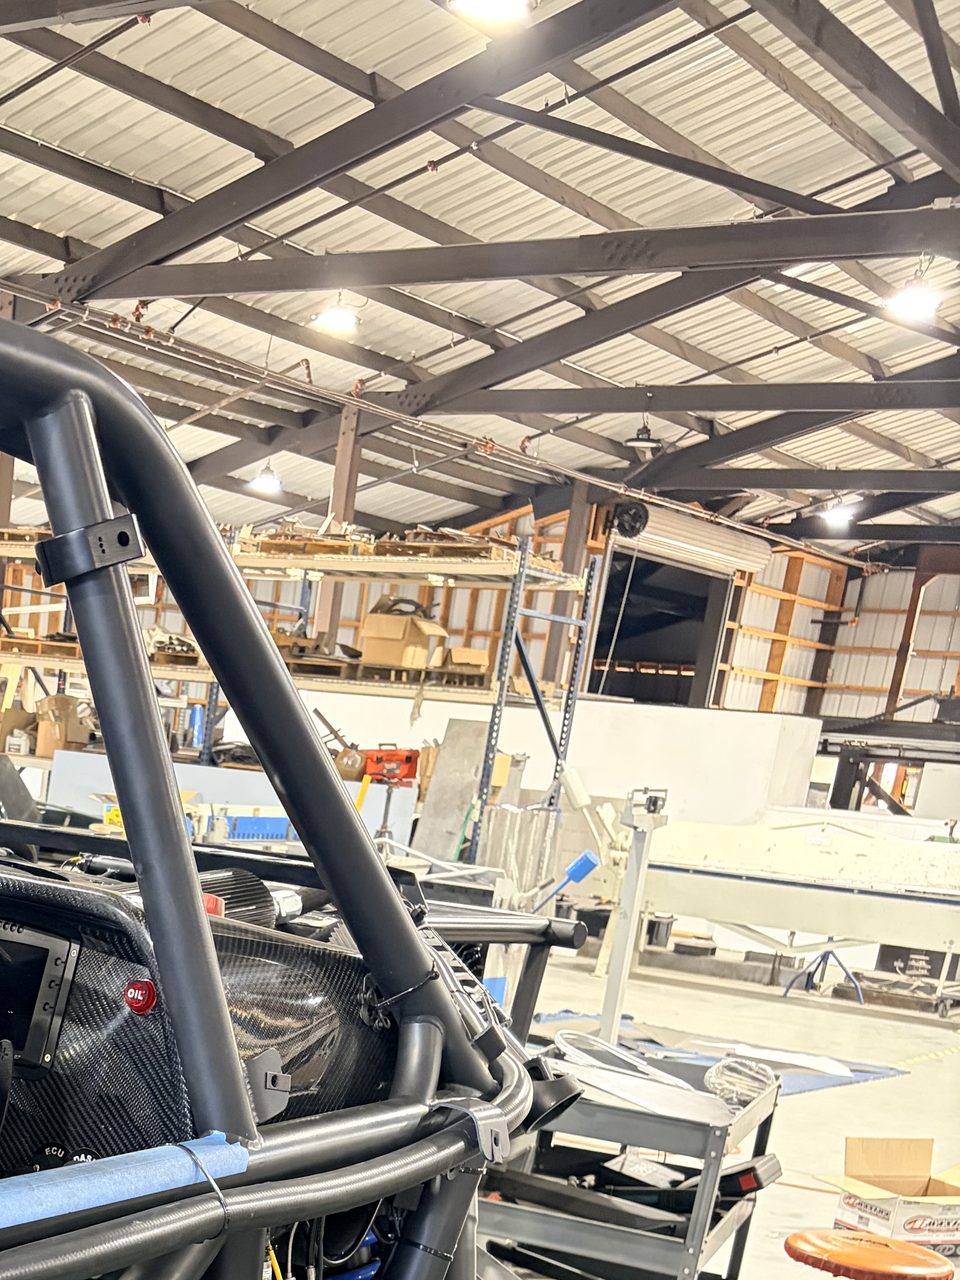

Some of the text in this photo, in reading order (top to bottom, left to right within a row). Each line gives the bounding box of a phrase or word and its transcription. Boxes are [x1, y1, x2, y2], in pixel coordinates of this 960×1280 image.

[127, 988, 144, 1001] OIL
[45, 1146, 65, 1158] ECU
[73, 1153, 96, 1163] DAS
